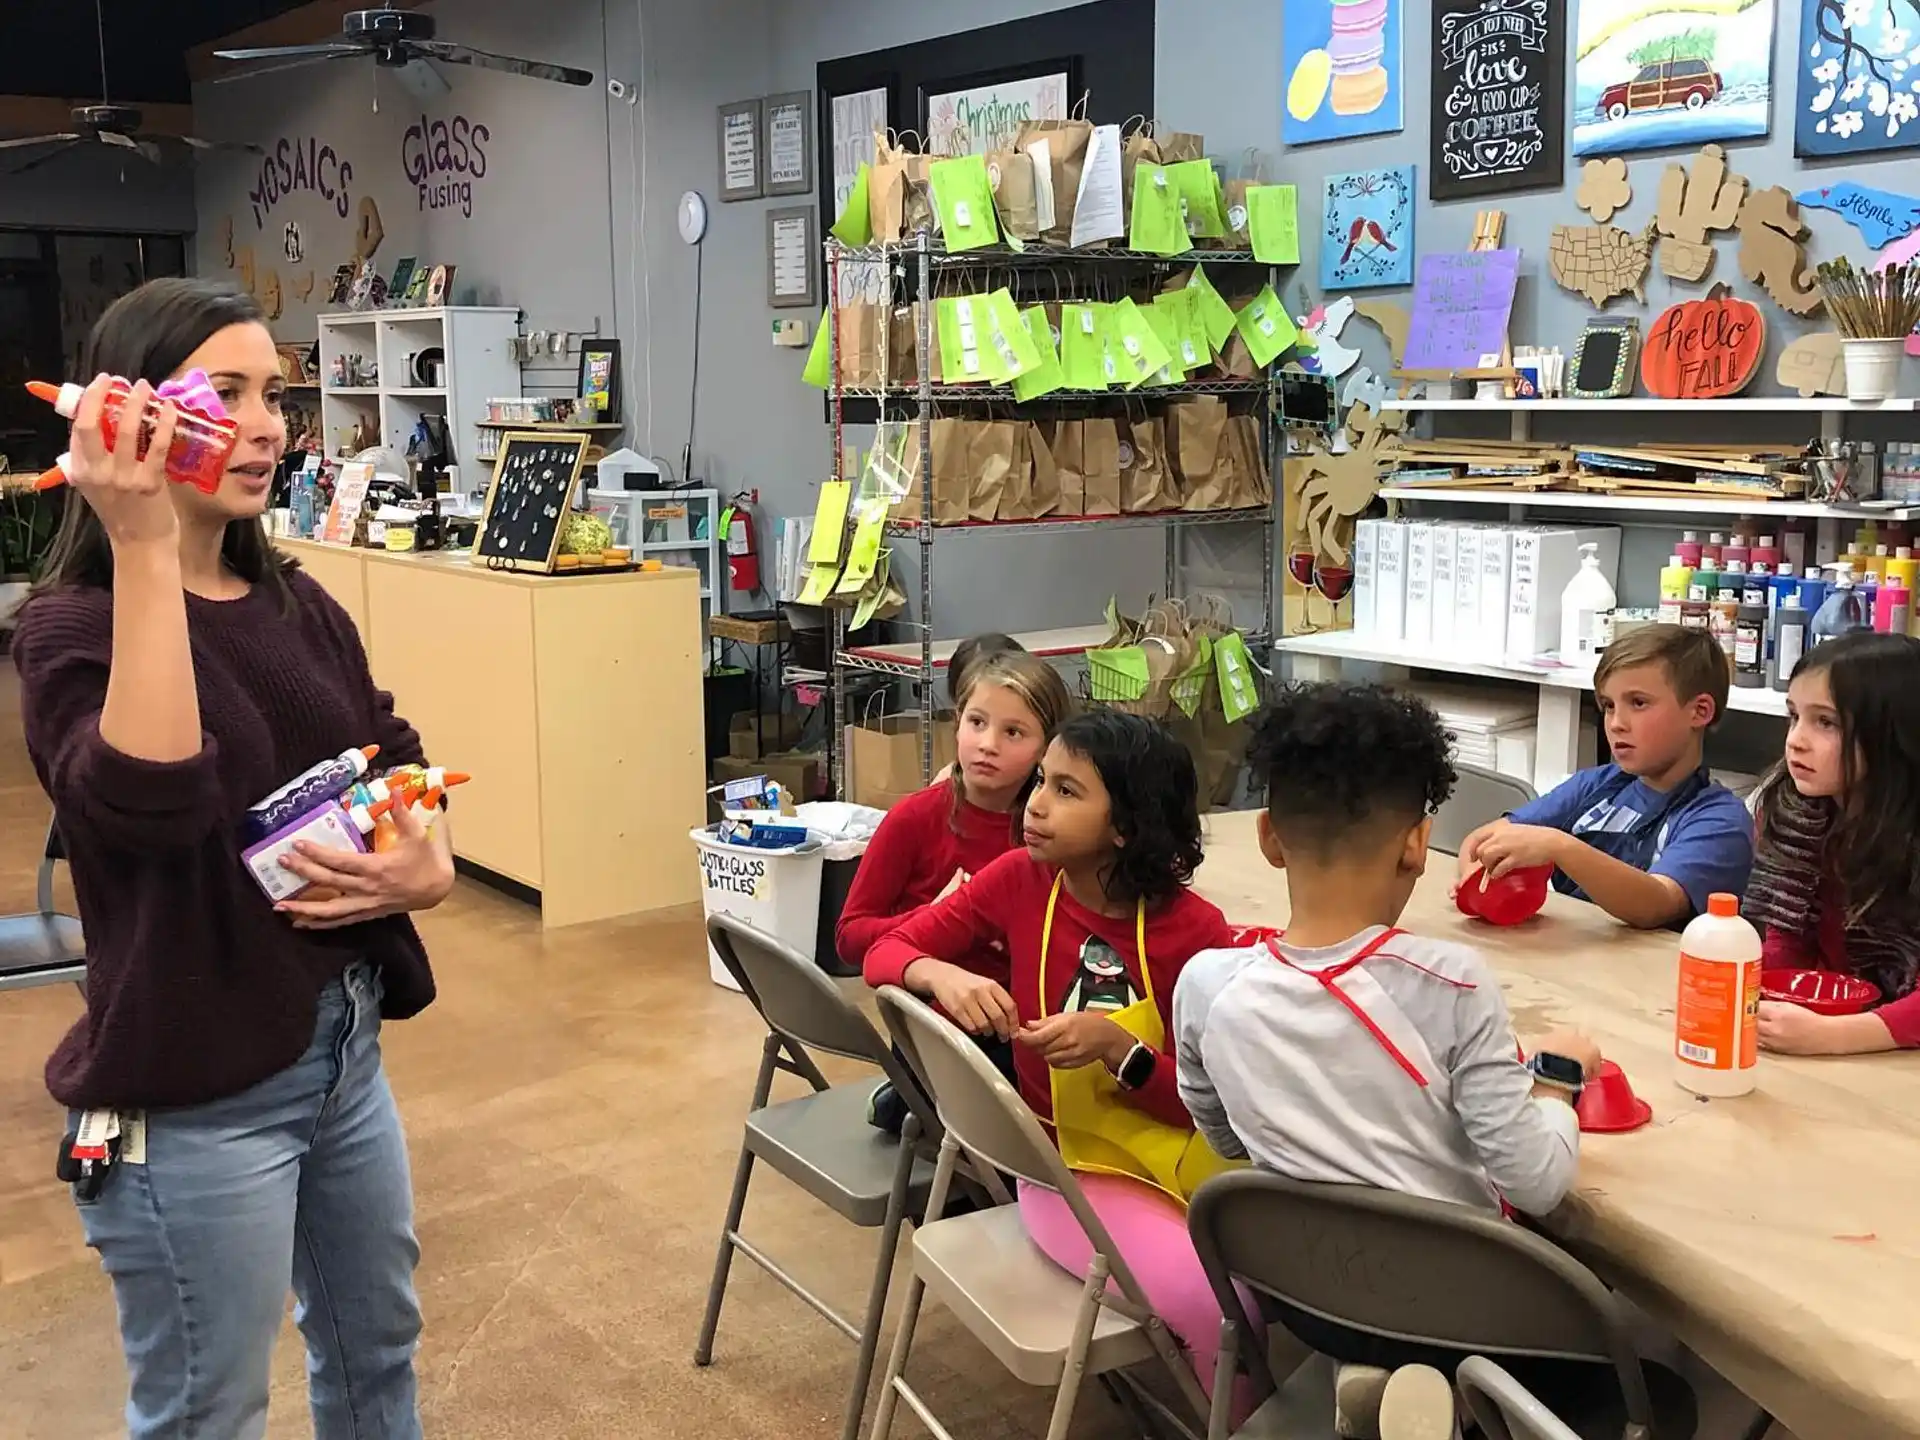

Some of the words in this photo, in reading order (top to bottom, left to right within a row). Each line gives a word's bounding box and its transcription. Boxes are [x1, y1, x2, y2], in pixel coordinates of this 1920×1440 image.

[1462, 25, 1481, 47] ALL
[1482, 17, 1500, 34] YOU
[1503, 16, 1525, 33] NEED
[1488, 42, 1498, 56] IS
[1460, 50, 1527, 89] love
[957, 93, 1030, 138] Christmas
[1445, 85, 1471, 116] &
[1471, 95, 1479, 114] A
[1482, 89, 1506, 113] GOOD
[1510, 85, 1529, 109] CUP
[1447, 108, 1539, 143] COFFEE
[402, 114, 489, 185] Glass
[249, 137, 352, 230] MOSAICS
[418, 175, 471, 219] Fusing
[1648, 308, 1754, 360] hello
[1678, 352, 1738, 399] FALL
[707, 869, 755, 896] BOTTLES
[730, 856, 764, 877] GLASS
